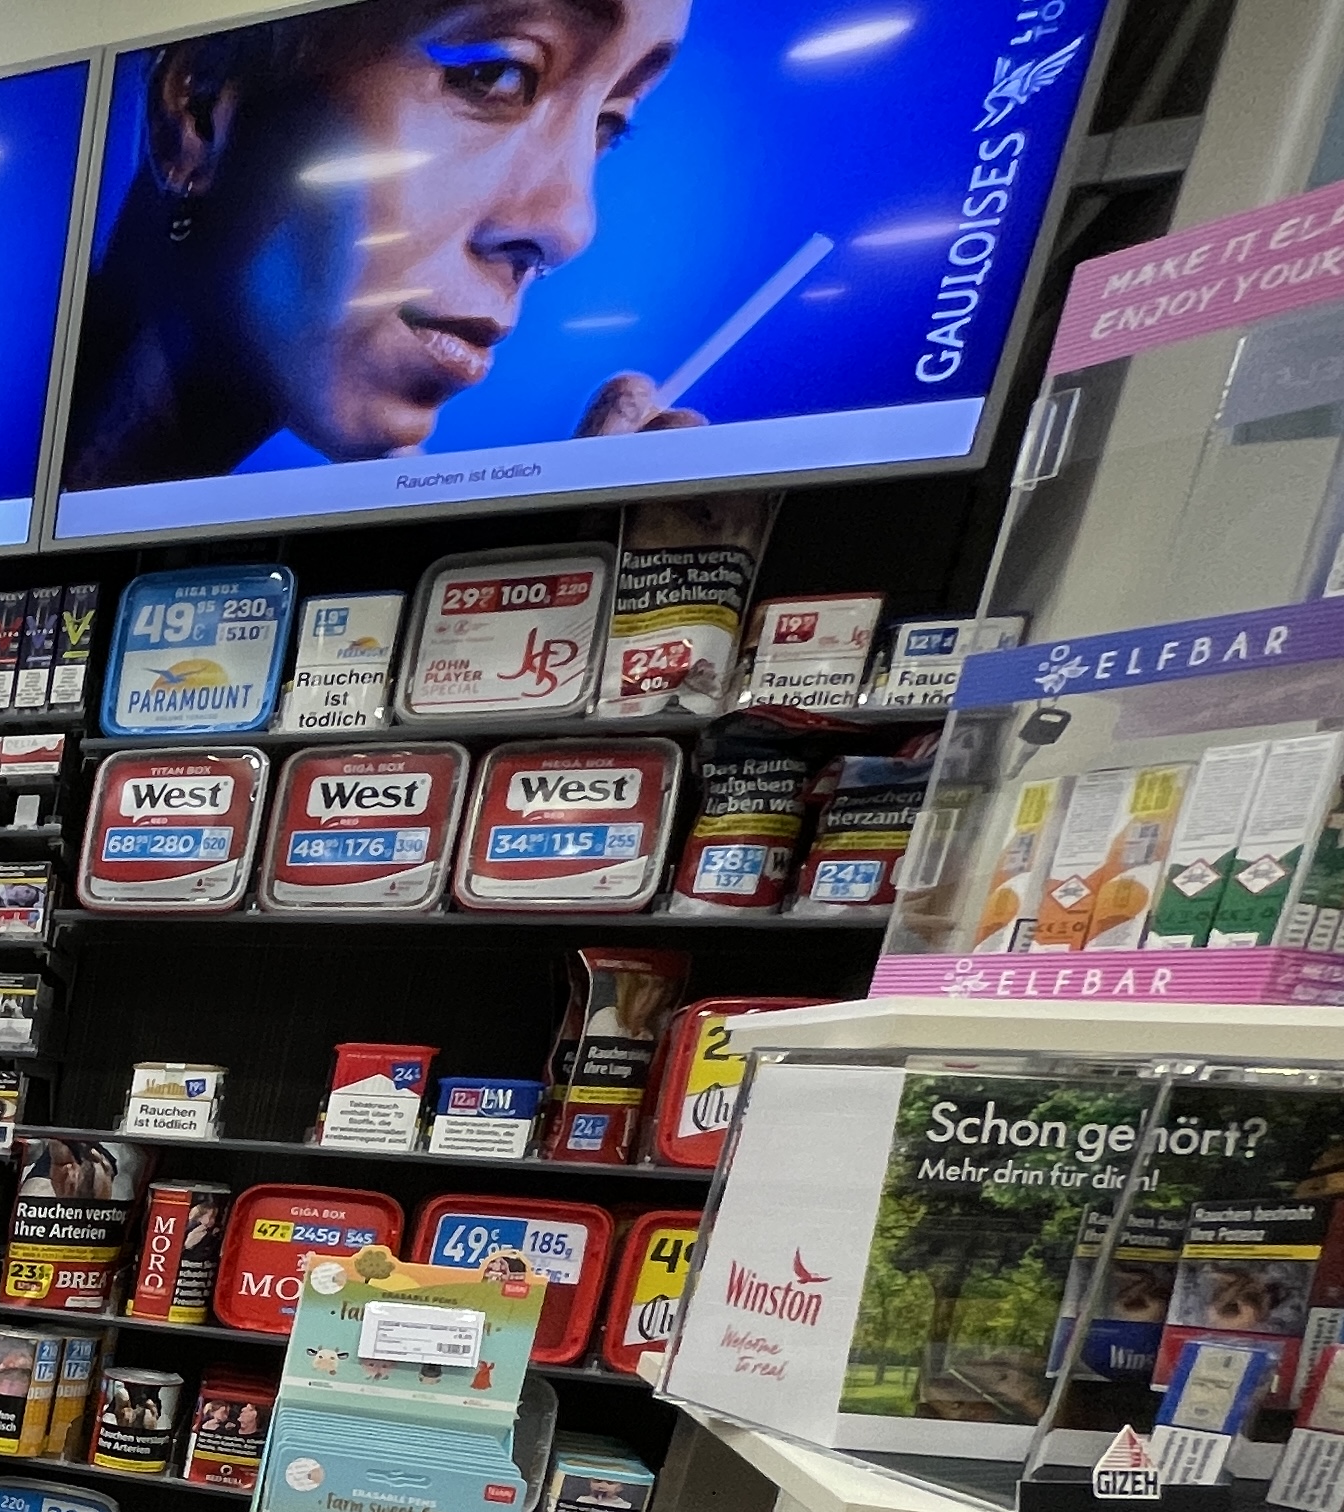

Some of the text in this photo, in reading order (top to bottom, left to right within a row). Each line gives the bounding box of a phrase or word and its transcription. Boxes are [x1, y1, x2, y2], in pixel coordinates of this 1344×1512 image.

[914, 133, 1025, 384] GAULOISES
[1101, 244, 1213, 298] MAKE
[1090, 246, 1344, 339] ENJOY YOUR
[396, 463, 541, 489] Rauchen ist tödlich
[622, 551, 694, 569] Rauchen
[69, 585, 96, 594] VEEV
[620, 570, 683, 590] Mund-,
[617, 594, 651, 612] und
[427, 658, 470, 671] JOHN
[1094, 625, 1290, 680] ELFBAR
[296, 669, 384, 688] Rauchen
[424, 669, 483, 684] PLAYER
[760, 670, 856, 689] Rauchen
[127, 683, 253, 714] PARAMOUNT
[323, 690, 350, 707] ist
[298, 709, 367, 729] tödlich
[132, 781, 223, 810] West
[319, 780, 418, 809] West
[521, 774, 631, 804] West
[996, 967, 1174, 996] ELFBAR
[139, 1104, 196, 1119] Rauchen
[134, 1117, 197, 1131] ist tödlich
[926, 1099, 1269, 1163] Schon gehört?
[917, 1158, 989, 1183] Mehr
[992, 1159, 1045, 1187] drin
[1049, 1162, 1086, 1189] für
[17, 1202, 83, 1220] Rauchen
[290, 1206, 346, 1221] GIGA BOX
[14, 1221, 106, 1240] Ihre Arterien
[256, 1223, 280, 1238] 47
[293, 1225, 340, 1245] 245g
[443, 1224, 573, 1263] 49 185g
[724, 1259, 823, 1327] Winston
[720, 1325, 784, 1358] Welcome
[1097, 1470, 1159, 1496] GIZEH
